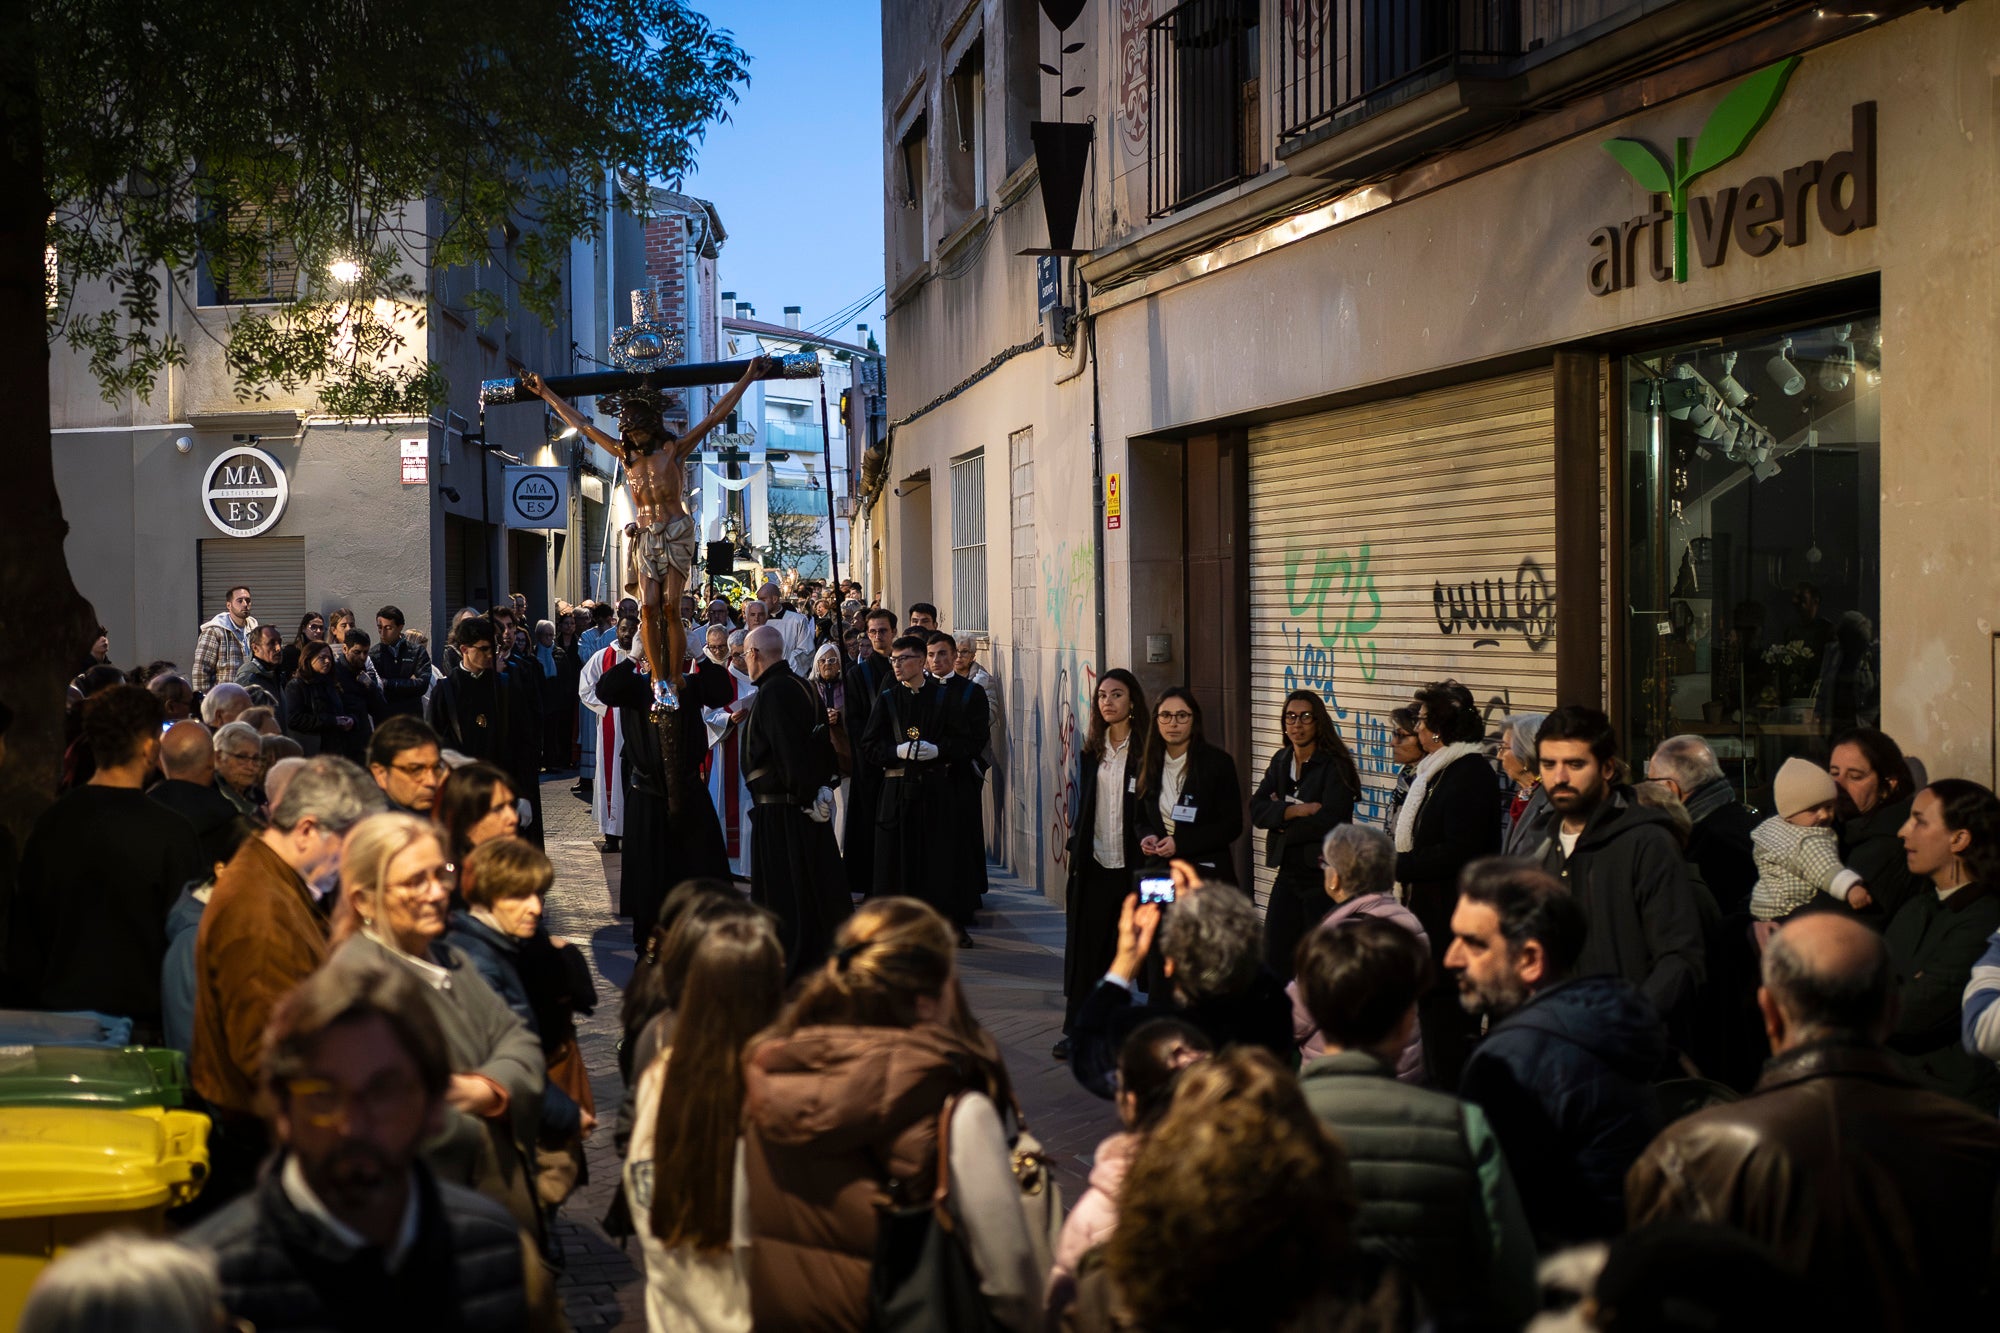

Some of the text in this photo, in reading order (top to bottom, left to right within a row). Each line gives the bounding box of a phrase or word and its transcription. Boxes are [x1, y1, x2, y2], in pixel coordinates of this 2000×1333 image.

[1587, 100, 1877, 297] artiverd
[224, 465, 263, 485] MA
[525, 483, 547, 494] MA
[228, 501, 259, 521] ES
[526, 501, 546, 512] ES
